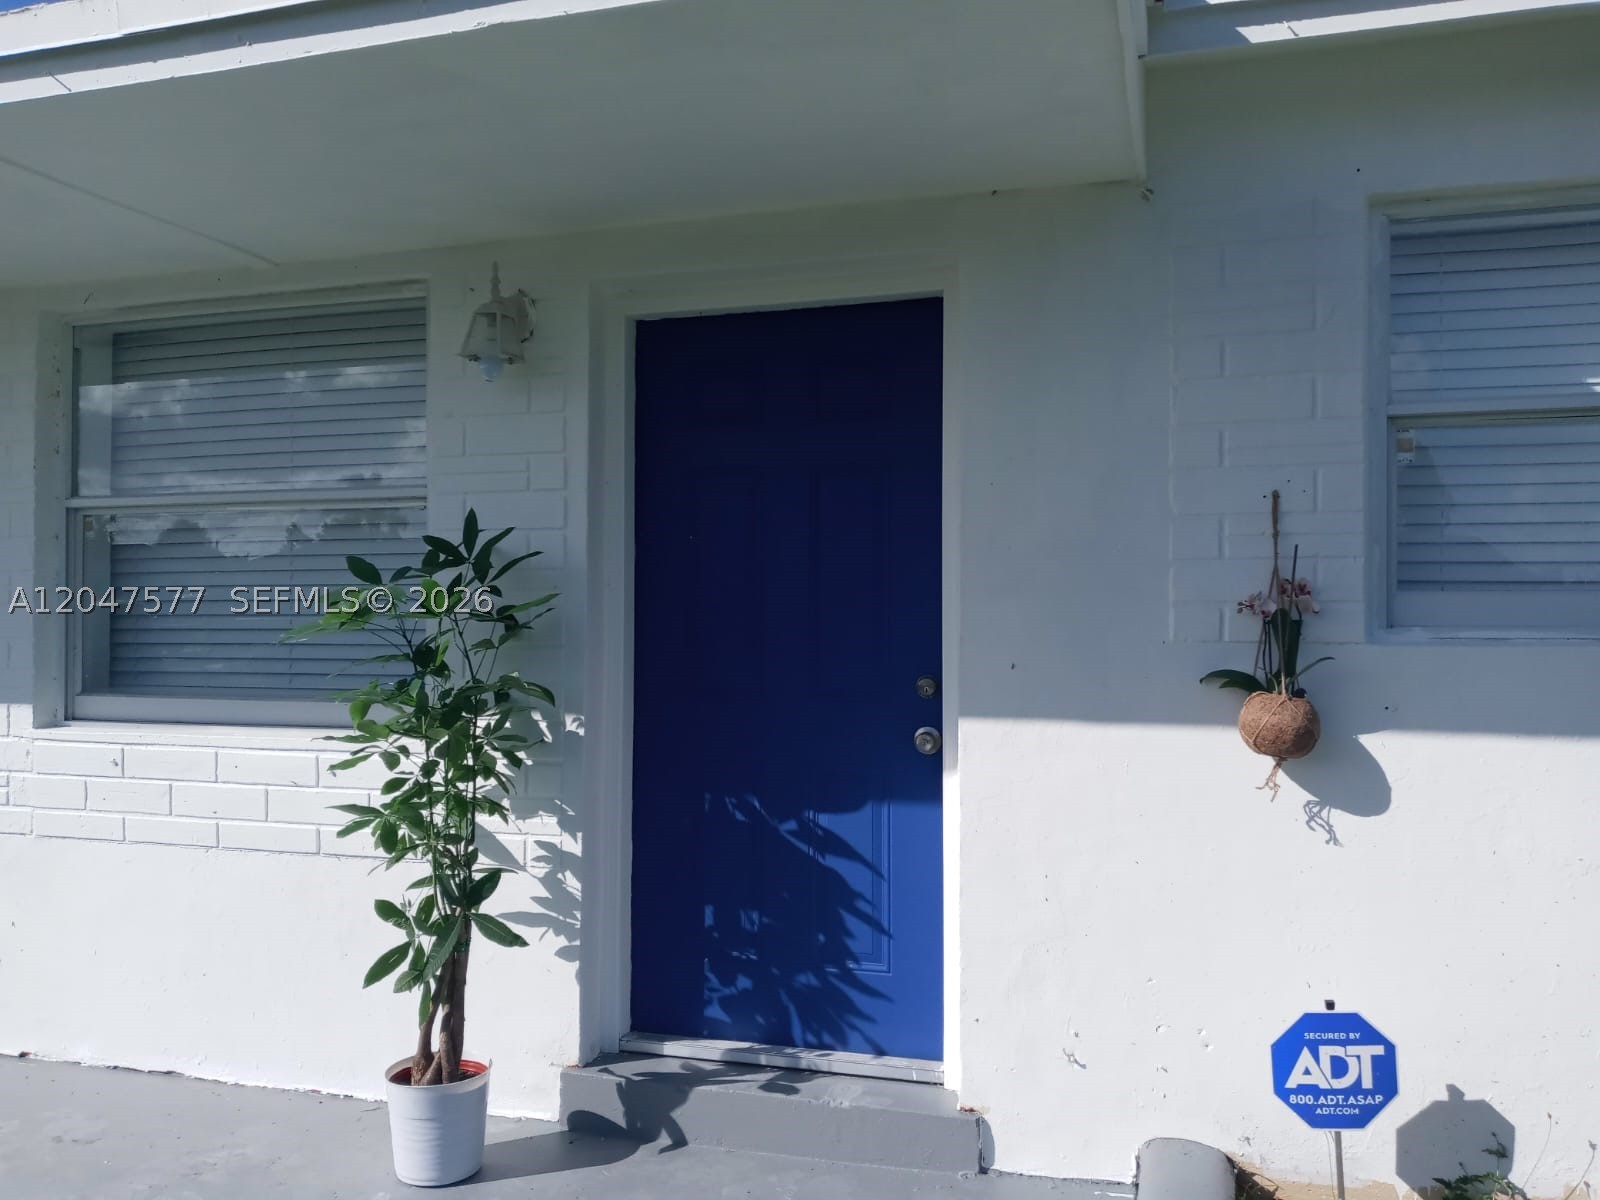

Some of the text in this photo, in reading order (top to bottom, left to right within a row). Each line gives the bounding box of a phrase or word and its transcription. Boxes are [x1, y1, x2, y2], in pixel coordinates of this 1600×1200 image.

[1304, 1032, 1361, 1040] SECURED BY
[1284, 1044, 1385, 1090] ADT
[1289, 1094, 1384, 1105] 800.ADT.ASAP
[1315, 1107, 1359, 1115] ADT.COM
